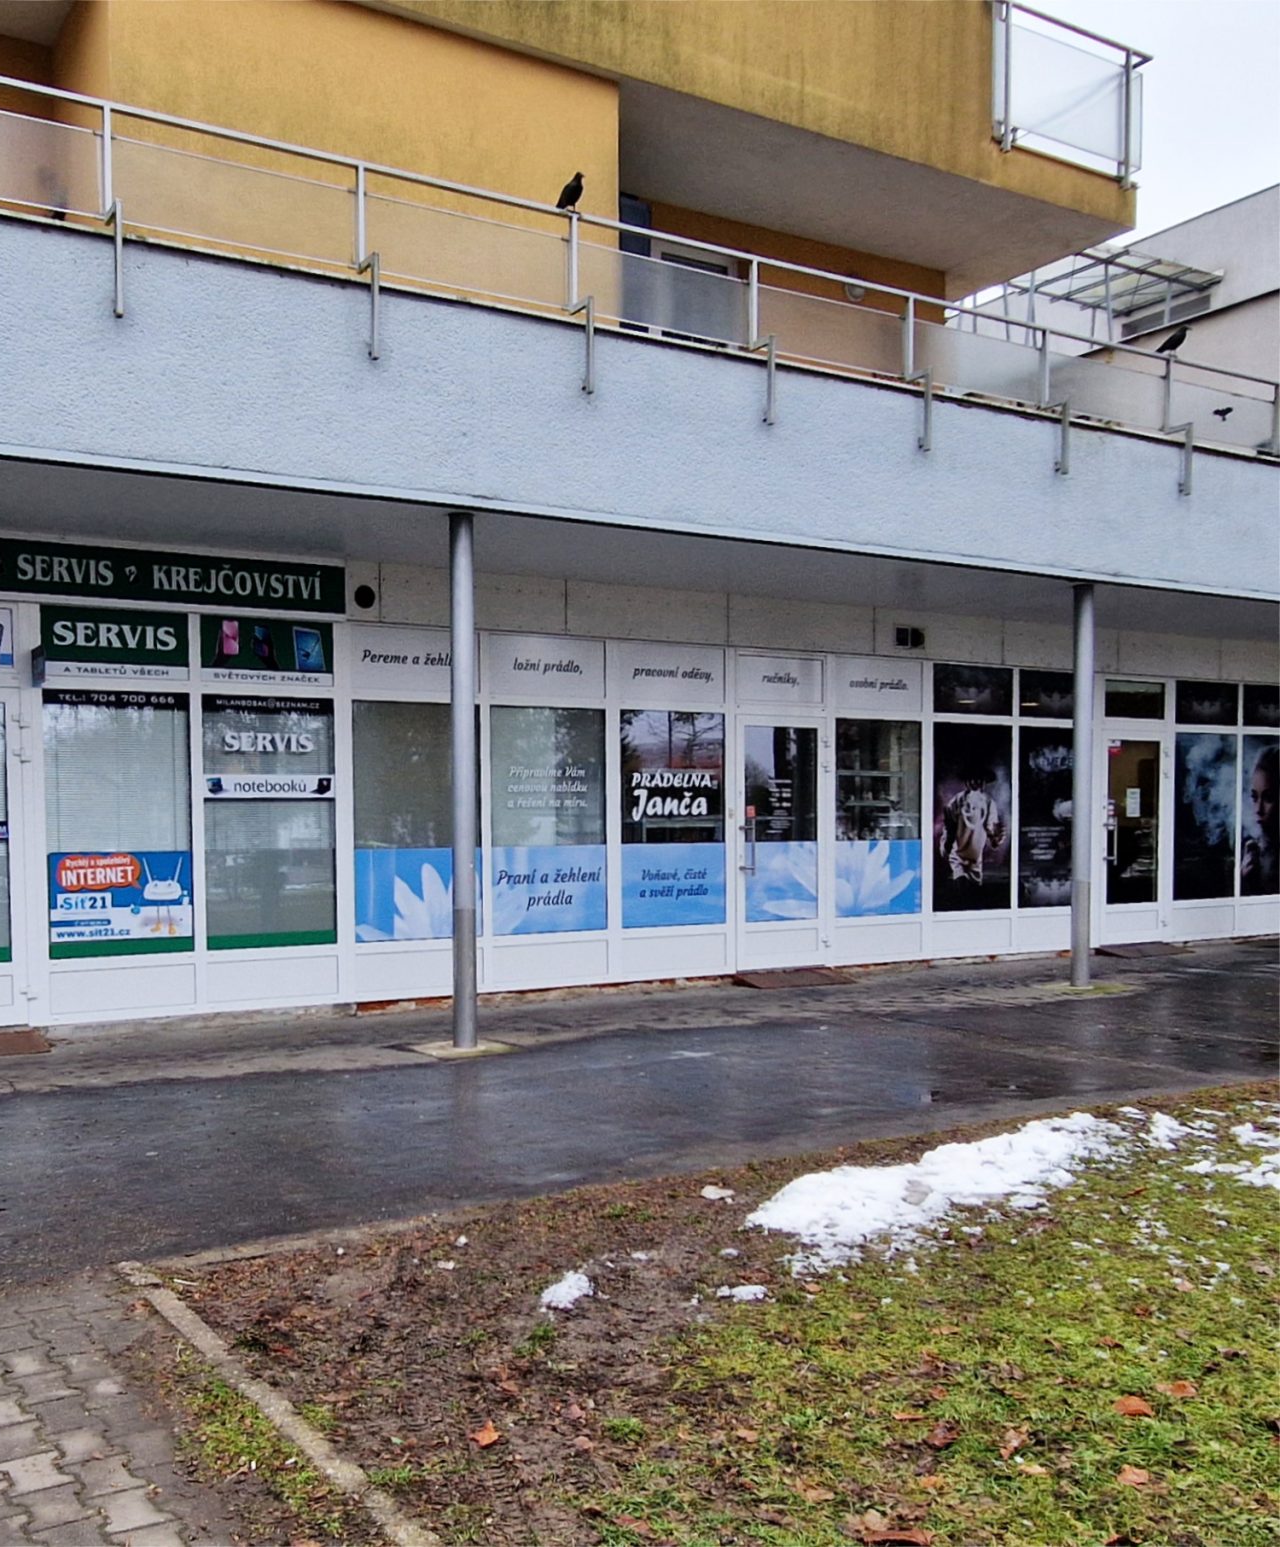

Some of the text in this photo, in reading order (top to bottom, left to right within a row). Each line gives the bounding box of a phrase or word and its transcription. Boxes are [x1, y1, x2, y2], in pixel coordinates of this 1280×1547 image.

[16, 553, 115, 587] SERVIS
[152, 564, 322, 600] KREJČOVSTVÍ
[52, 621, 178, 651] SERVIS
[362, 649, 408, 665] Pereme
[412, 656, 420, 665] a
[63, 665, 170, 677] A TABLETŮ VŠECH
[513, 658, 584, 675] ložní prádlo,
[632, 666, 714, 684] pracovní oděvy,
[90, 694, 117, 703] 704
[121, 695, 148, 704] 700
[224, 731, 314, 753] SERVIS
[234, 779, 308, 793] notebooků
[550, 781, 588, 793] nabídku
[631, 769, 712, 788] PRÁDELNA
[507, 799, 514, 808] a
[631, 788, 708, 822] Janča
[61, 866, 134, 887] INTERNET
[497, 867, 602, 886] Praní a žehlení
[527, 890, 573, 911] prádla
[639, 889, 647, 898] a
[675, 884, 709, 900] prádlo
